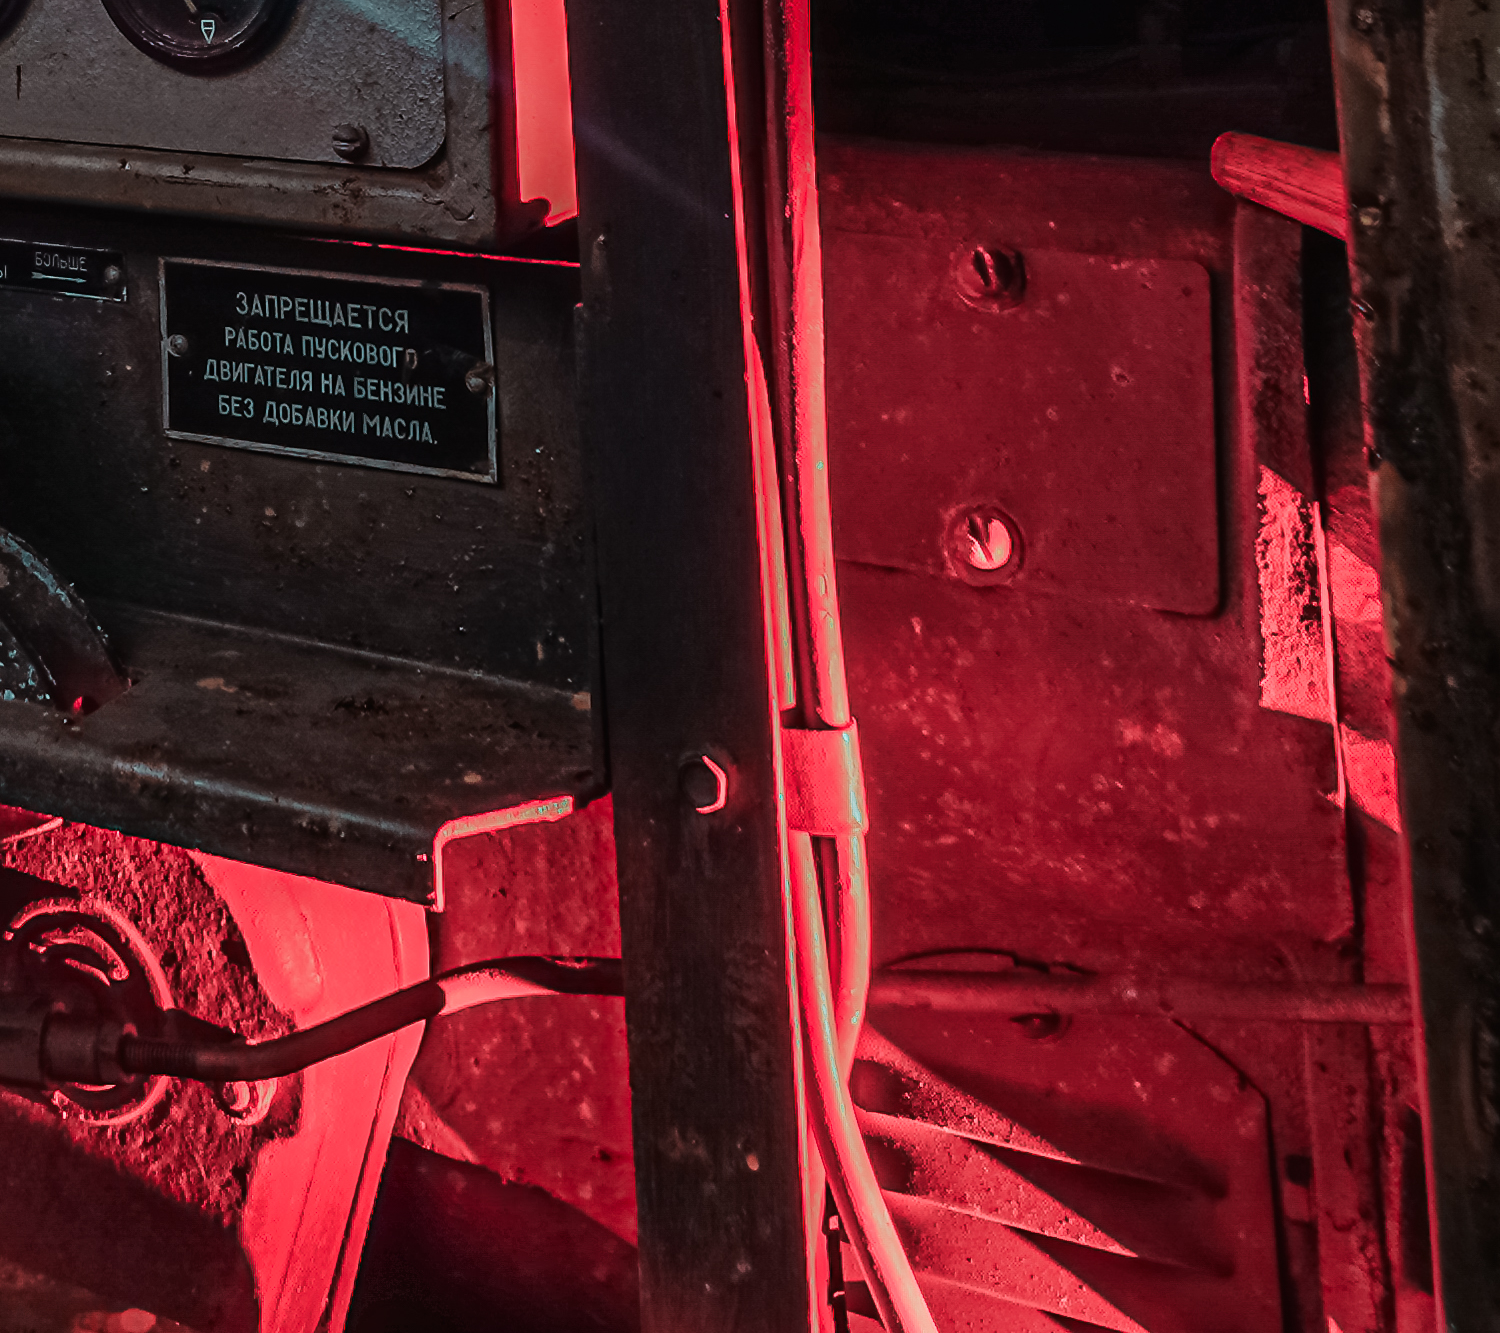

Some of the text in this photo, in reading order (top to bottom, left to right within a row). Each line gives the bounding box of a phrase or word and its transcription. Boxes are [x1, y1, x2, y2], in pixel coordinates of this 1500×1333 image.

[35, 251, 88, 272] БОЛЬШЕ
[235, 291, 410, 334] ЗАПРЕЩАЕТСЯ
[224, 325, 418, 369] РАБОТА ПУСКОВОГО
[204, 359, 448, 410] ДВИГАТЕЛЯ НА БЕНЗИНЕ
[218, 395, 438, 445] БЕЗ ДОБАВКИ МАСЛА.
